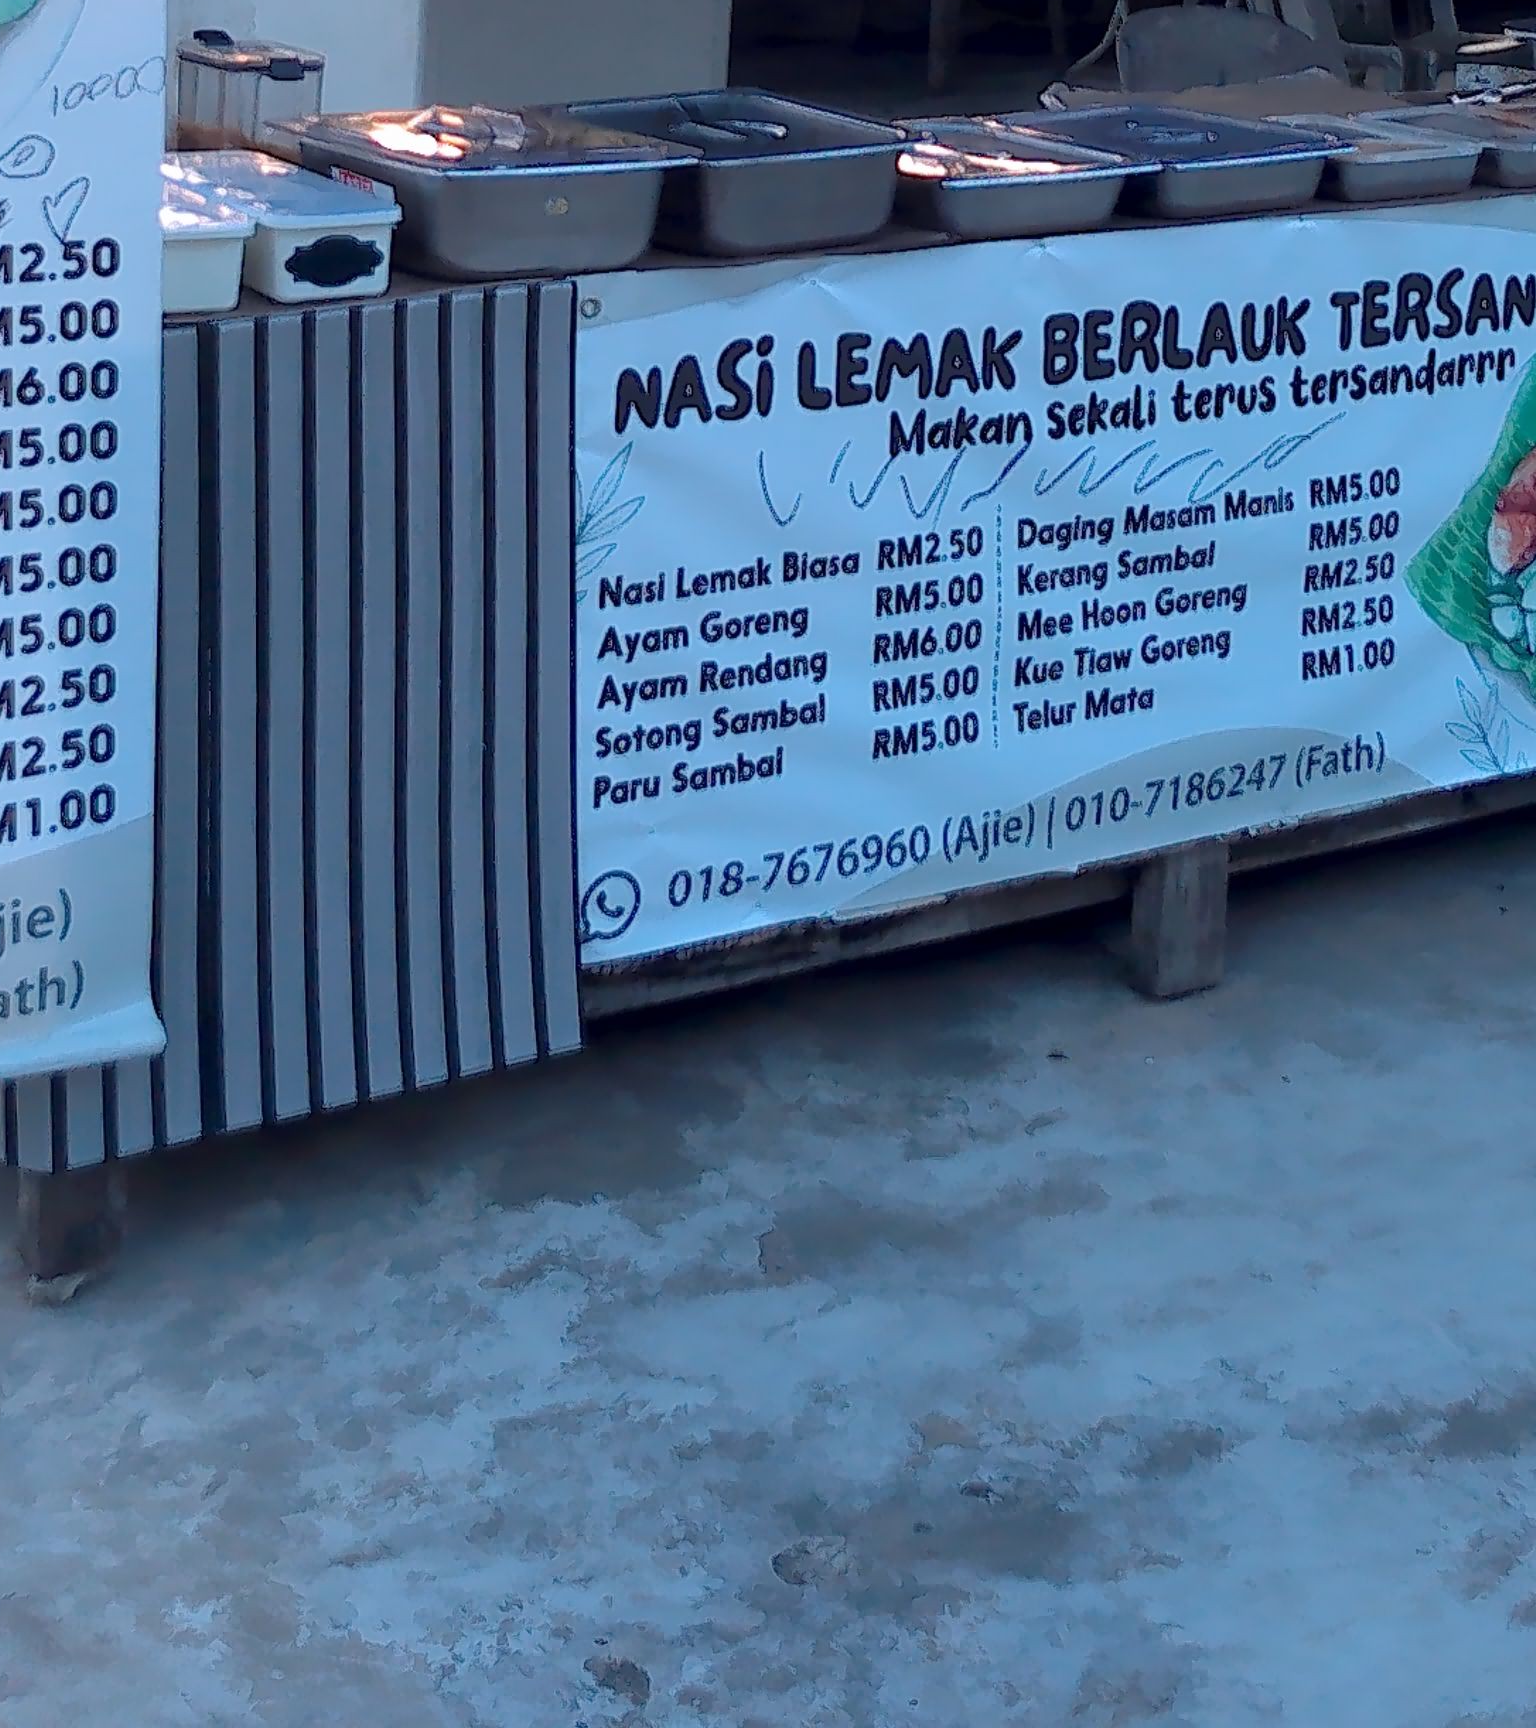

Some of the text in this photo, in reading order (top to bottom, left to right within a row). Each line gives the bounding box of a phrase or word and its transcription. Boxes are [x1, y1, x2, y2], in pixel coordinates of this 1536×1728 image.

[797, 325, 1023, 411] LEMAK
[1042, 295, 1311, 386] BERLAUK
[889, 405, 1033, 457] Makan
[1171, 371, 1276, 424] terus
[1291, 345, 1516, 405] tersandarrr
[1017, 466, 1400, 551] Daging Masam Manis RM5.00
[1017, 510, 1400, 597] Kerang Sambal RM5.00
[599, 525, 983, 609] Nasi Lemak Biasa RM2.50
[1017, 552, 1394, 642] Mee Hoon Goreng RM2.50
[597, 572, 984, 663] Ayam Goreng RM5.00
[1015, 594, 1394, 688] Kue Tiaw Goreng RM2.50
[595, 665, 979, 759] Sotong Sambal RM5.00
[597, 618, 982, 712] Ayam Rendang RM6.00
[1014, 637, 1395, 733] Telur Mata RM1.00
[593, 711, 979, 808] Paru Sambal RM5.00
[668, 825, 930, 908] 018-7676960
[942, 801, 1036, 863] (Ajie)
[1065, 753, 1286, 832] 010-7186247
[1295, 731, 1386, 788] (Fath)
